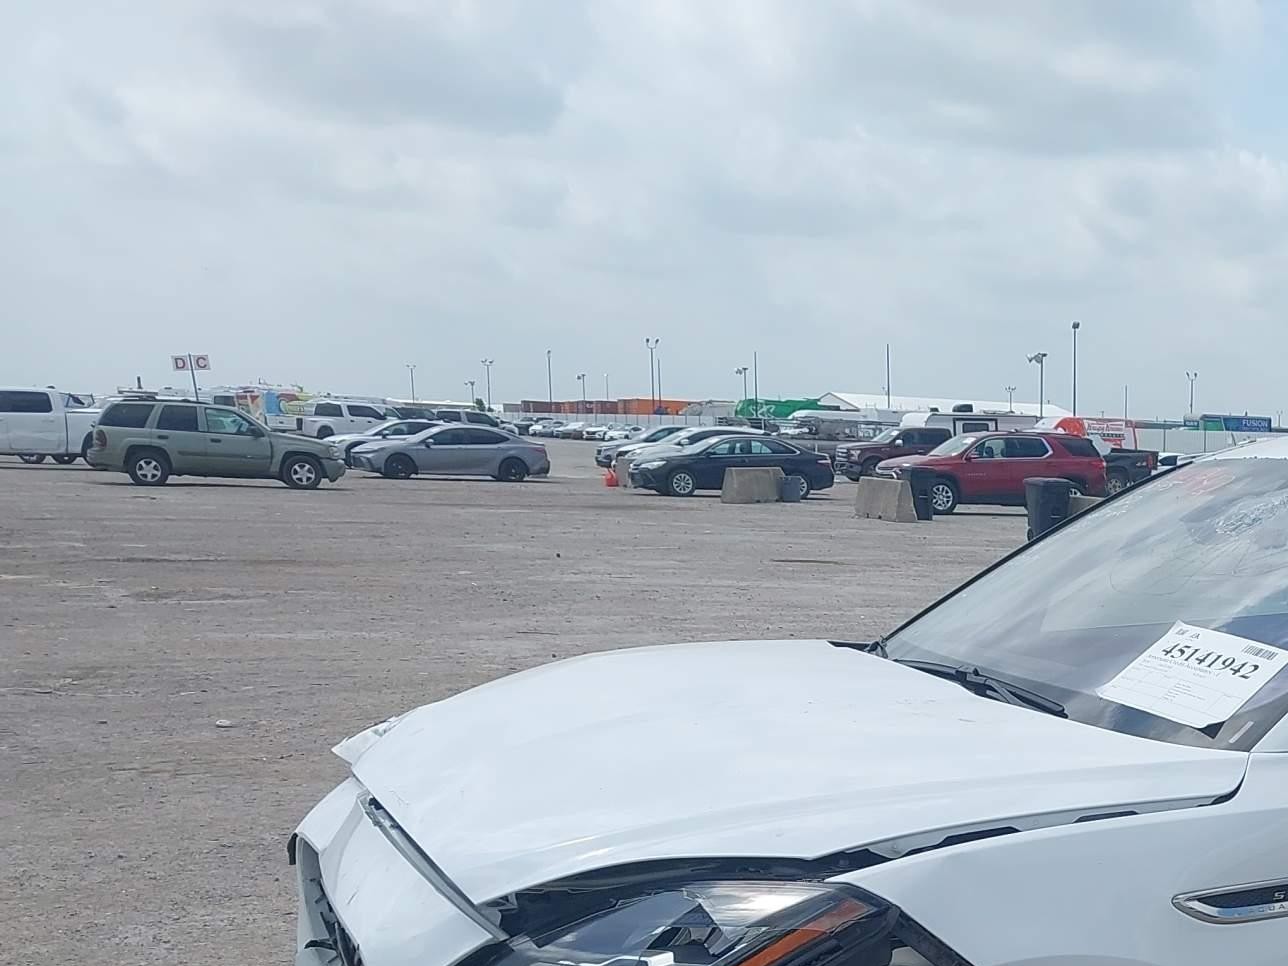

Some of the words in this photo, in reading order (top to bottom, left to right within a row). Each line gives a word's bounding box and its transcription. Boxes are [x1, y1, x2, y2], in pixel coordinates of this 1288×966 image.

[174, 357, 186, 369] D
[196, 356, 207, 369] C
[1242, 419, 1269, 428] FUSION
[1161, 642, 1261, 680] 45141942
[1272, 891, 1286, 900] S
